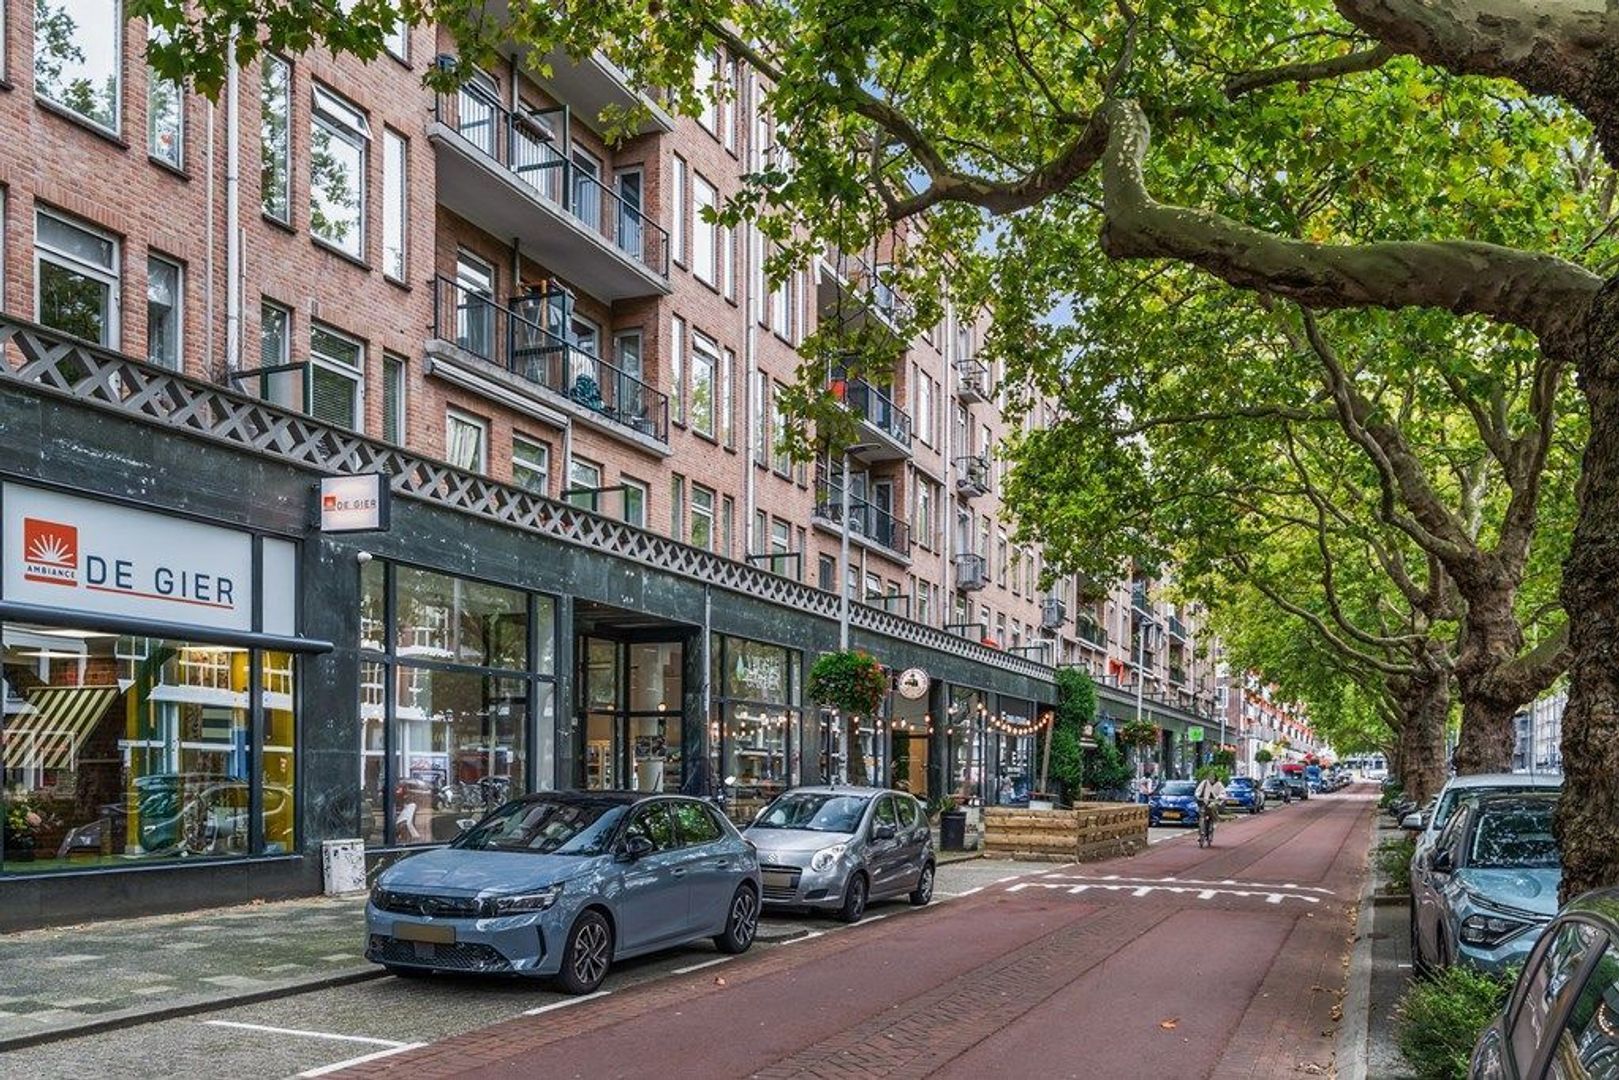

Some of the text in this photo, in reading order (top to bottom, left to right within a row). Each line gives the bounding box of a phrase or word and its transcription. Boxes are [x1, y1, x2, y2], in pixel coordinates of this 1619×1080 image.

[337, 499, 377, 511] DE GIER
[27, 564, 76, 578] AMBIANCE
[87, 555, 233, 605] DE GIER
